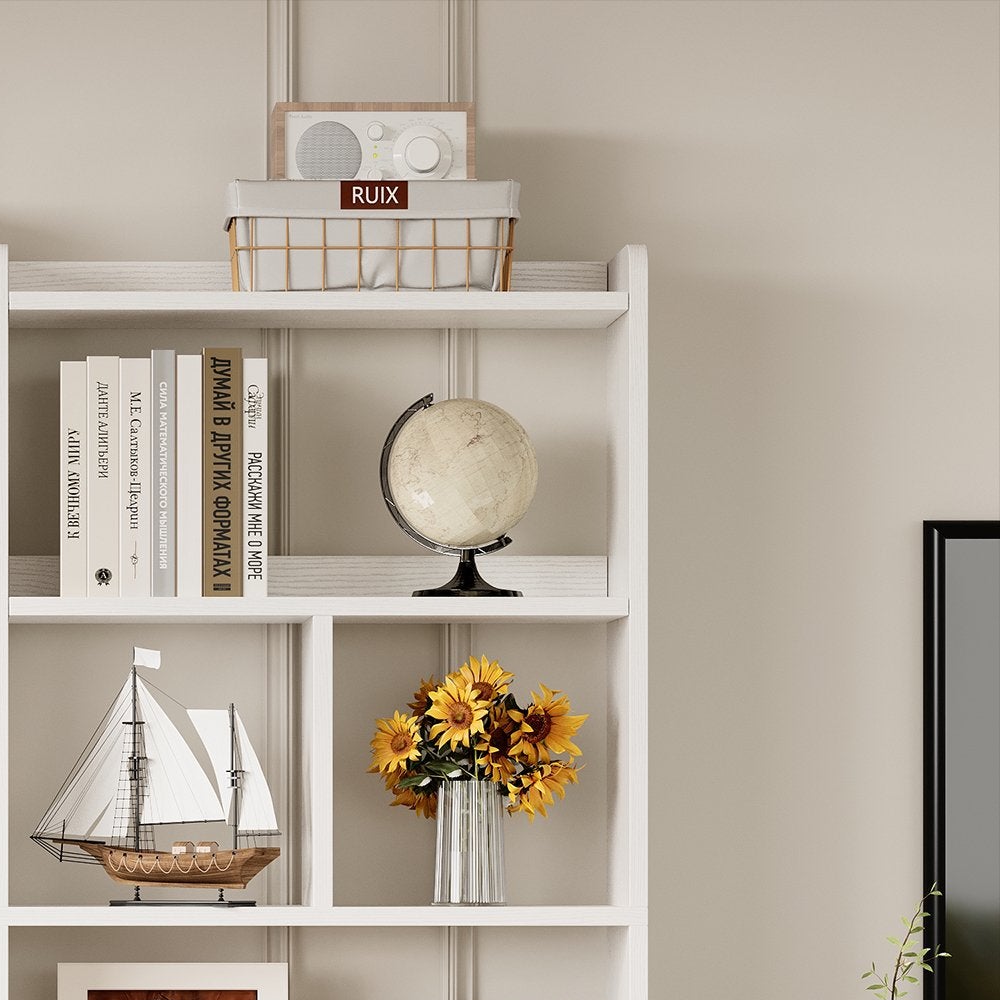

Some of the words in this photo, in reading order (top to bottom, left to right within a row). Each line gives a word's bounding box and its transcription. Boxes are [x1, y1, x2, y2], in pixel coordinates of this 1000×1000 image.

[352, 186, 399, 204] RUIX
[96, 382, 108, 418] ДАНТЕ
[130, 392, 142, 416] М.Е.
[158, 381, 168, 408] СИЛА
[211, 357, 235, 410] ДУМАЙ
[213, 416, 231, 426] В
[68, 428, 80, 465] МИРУ
[98, 420, 108, 478] АЛИГЬЕРИ
[158, 412, 168, 508] МАТЕМАТИЧЕСКОГО
[211, 431, 231, 490] ДРУГИХ
[124, 418, 142, 530] Салтыков-Щедрин
[248, 452, 263, 510] РАССКАЖИ
[68, 470, 80, 528] ВЕЧНОМУ
[68, 531, 80, 539] К
[158, 510, 168, 570] МЫШЛЕНИЯ
[213, 496, 231, 578] ФОРМАТАХ
[248, 514, 263, 536] МНЕ
[248, 550, 263, 580] МОРЕ
